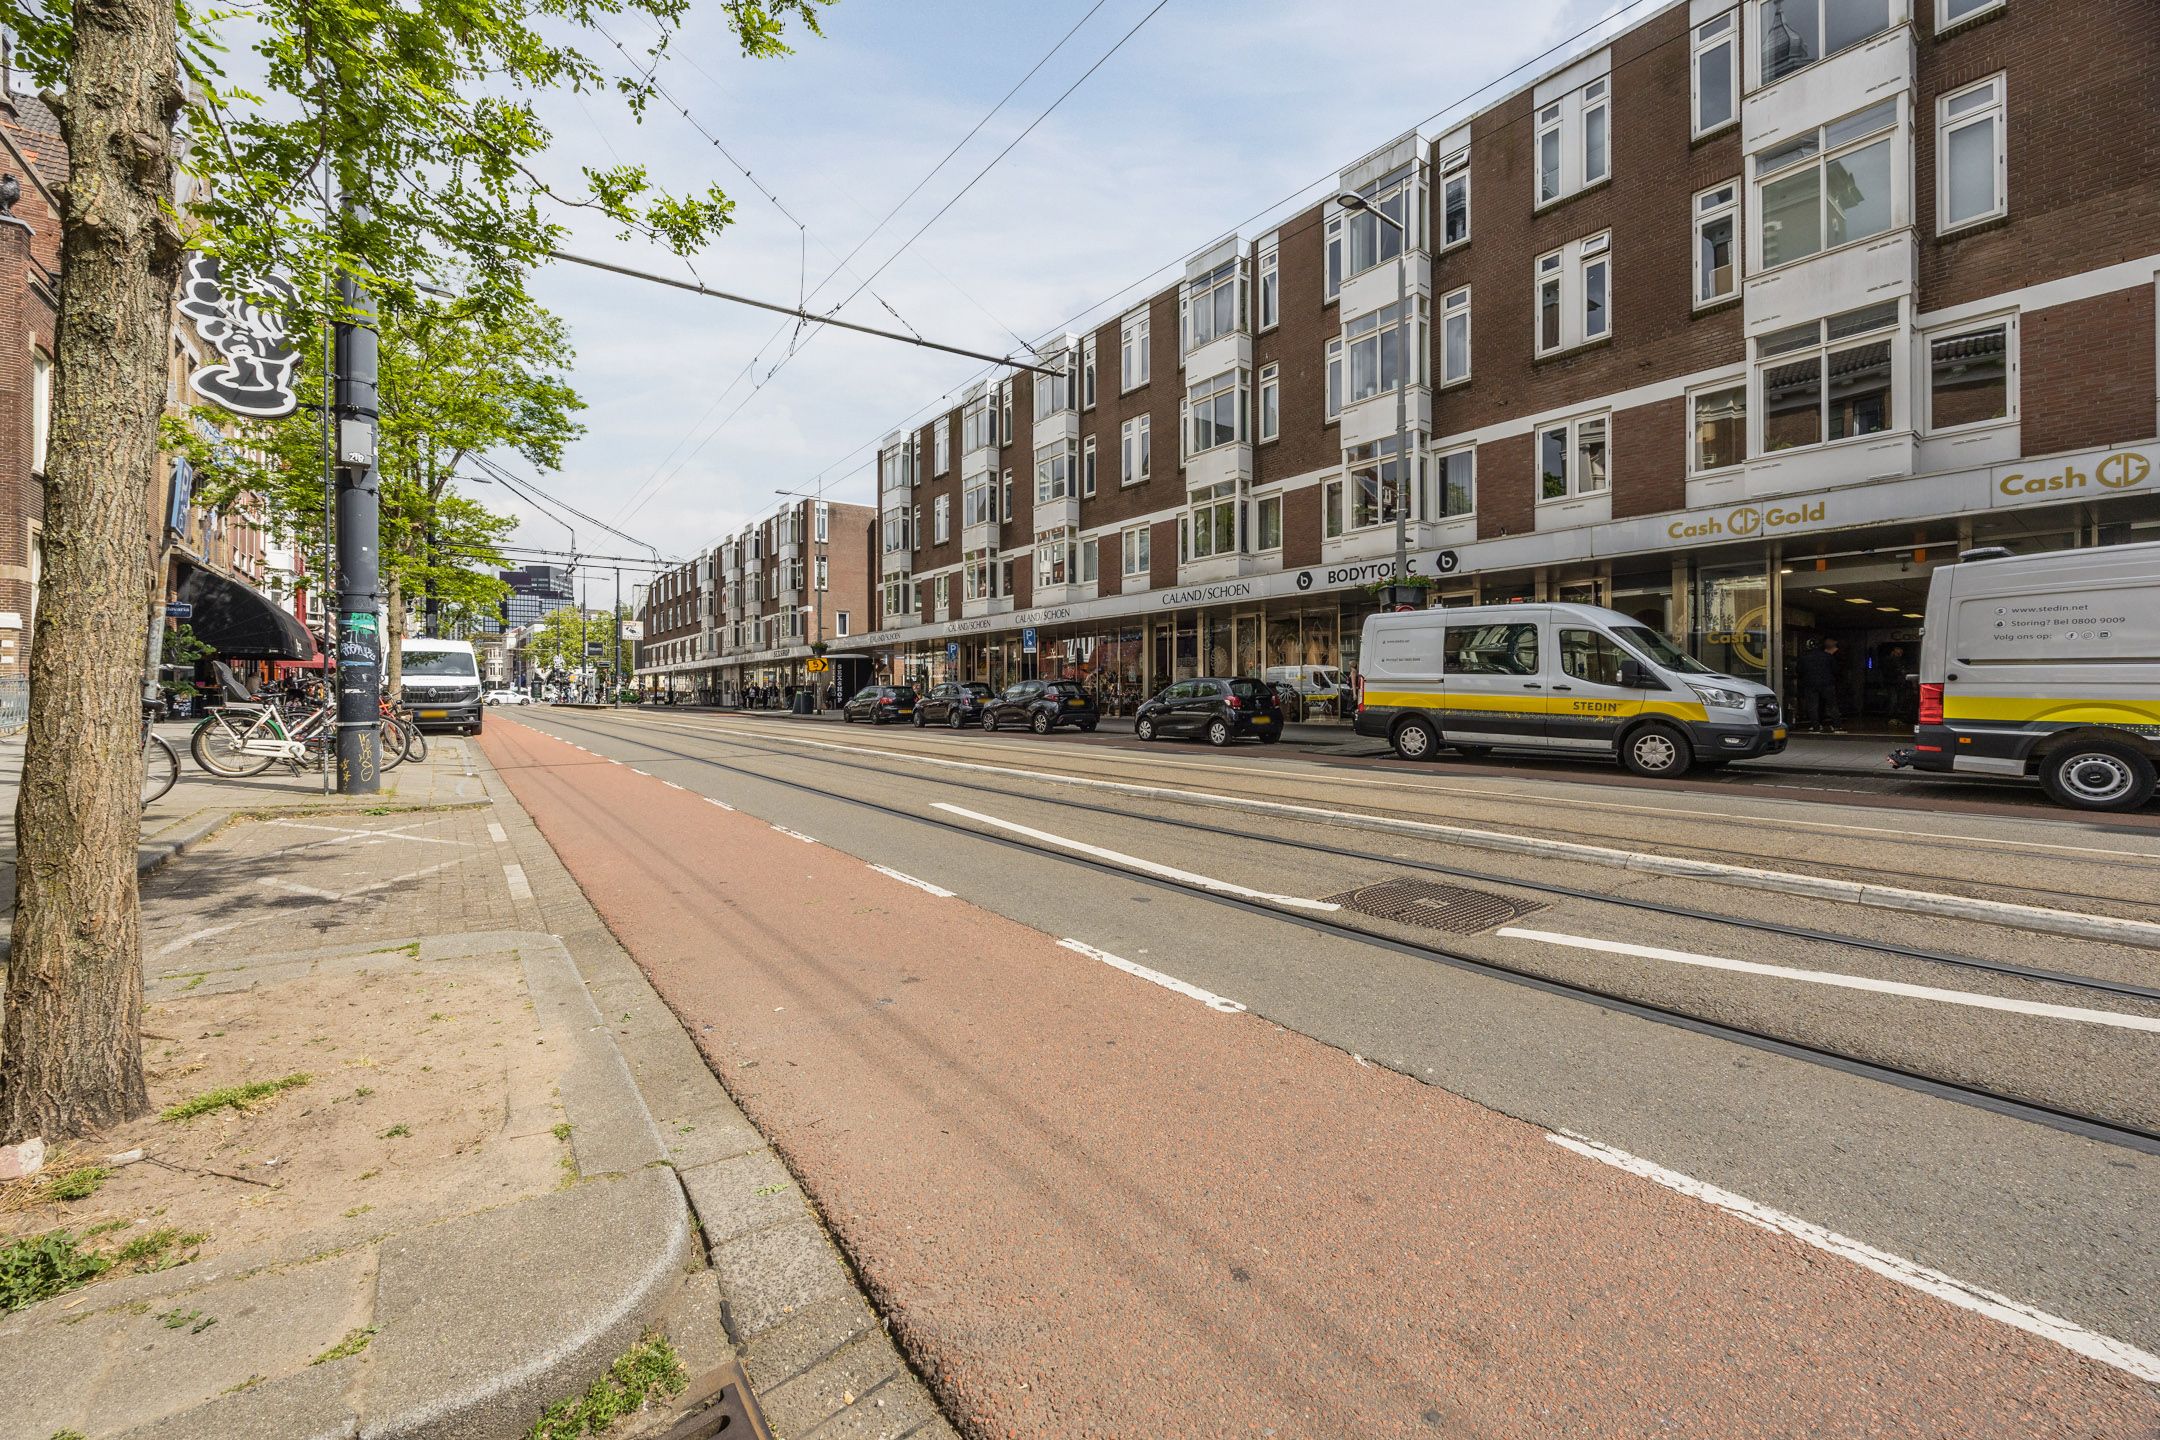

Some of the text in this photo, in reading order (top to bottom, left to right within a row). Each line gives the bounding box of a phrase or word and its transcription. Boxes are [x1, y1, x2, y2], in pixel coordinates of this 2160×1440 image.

[2000, 466, 2086, 496] Cash
[1668, 517, 1722, 539] Cash
[1765, 501, 1825, 527] Gold
[1328, 559, 1417, 584] BODYTOPC
[1162, 583, 1250, 605] CALAND/SCHOEN
[1015, 608, 1070, 624] CALAND/SCHOEN
[2011, 604, 2088, 614] www.stedin.net
[2011, 616, 2126, 628] Storing? Bel 0800 9009
[1026, 630, 1033, 640] P
[1707, 628, 1751, 645] Cash
[1993, 633, 2014, 642] Volg
[2036, 633, 2053, 641] op:
[950, 644, 956, 653] P
[1573, 701, 1617, 712] STEDIN
